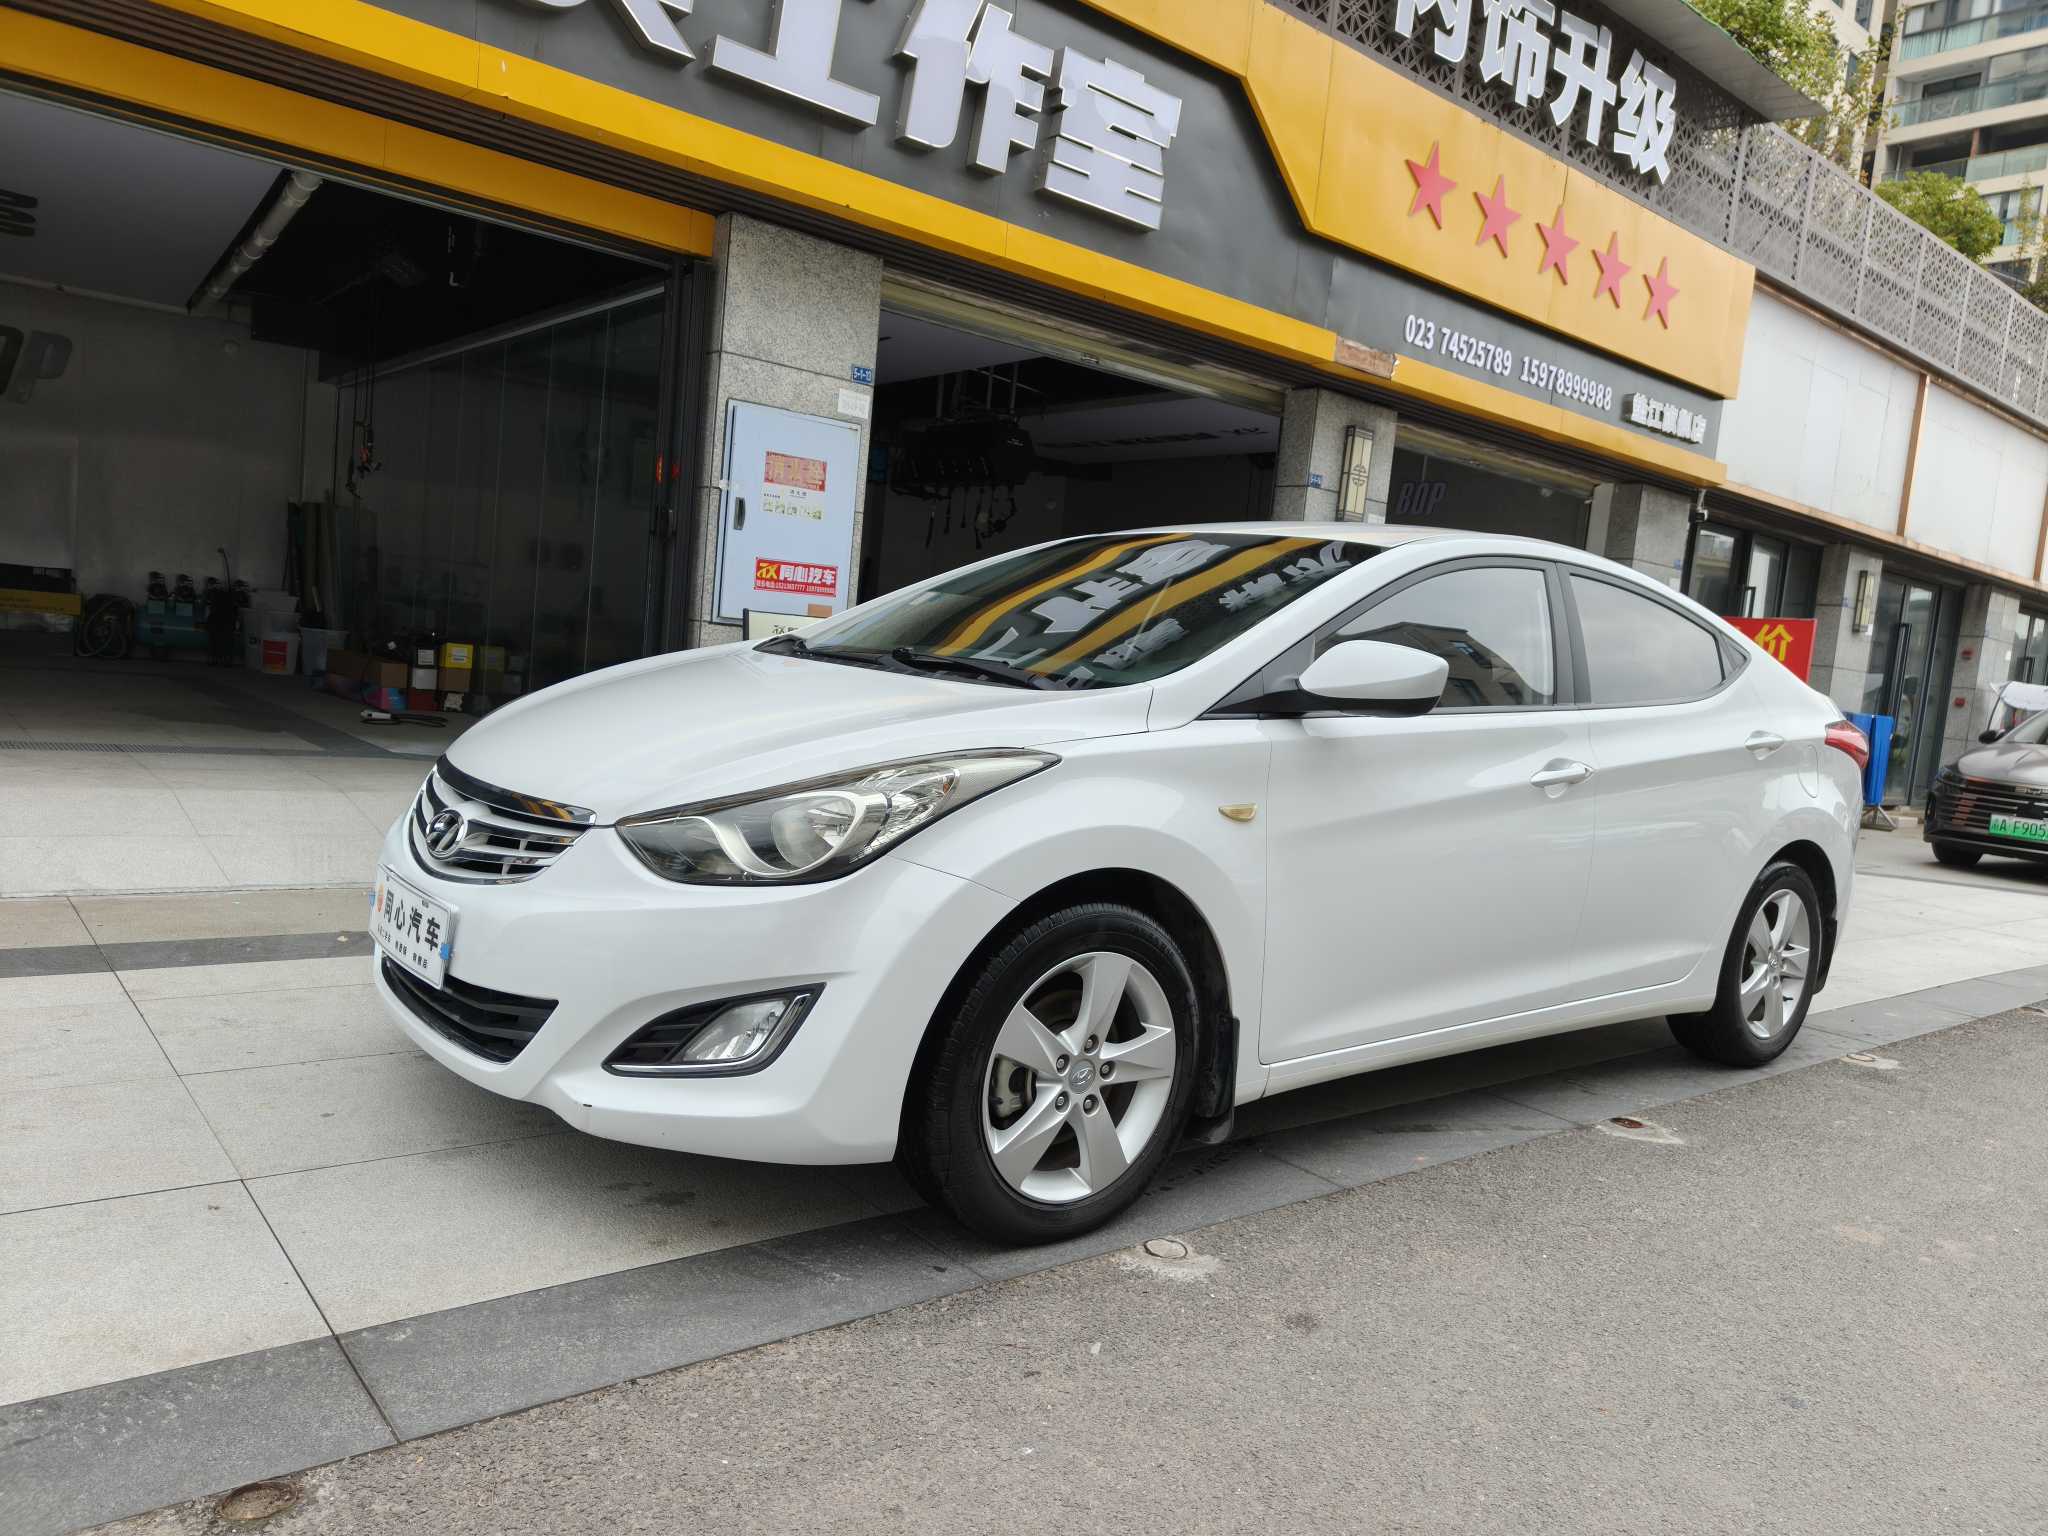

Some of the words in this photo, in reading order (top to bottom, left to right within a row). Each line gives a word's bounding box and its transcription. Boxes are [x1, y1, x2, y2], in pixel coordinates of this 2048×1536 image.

[1404, 314, 1435, 350] 023
[1440, 327, 1513, 377] 74525789
[1520, 355, 1613, 412] 15978999988
[779, 564, 836, 585] 同心汽车
[384, 888, 441, 952] 同心汽车
